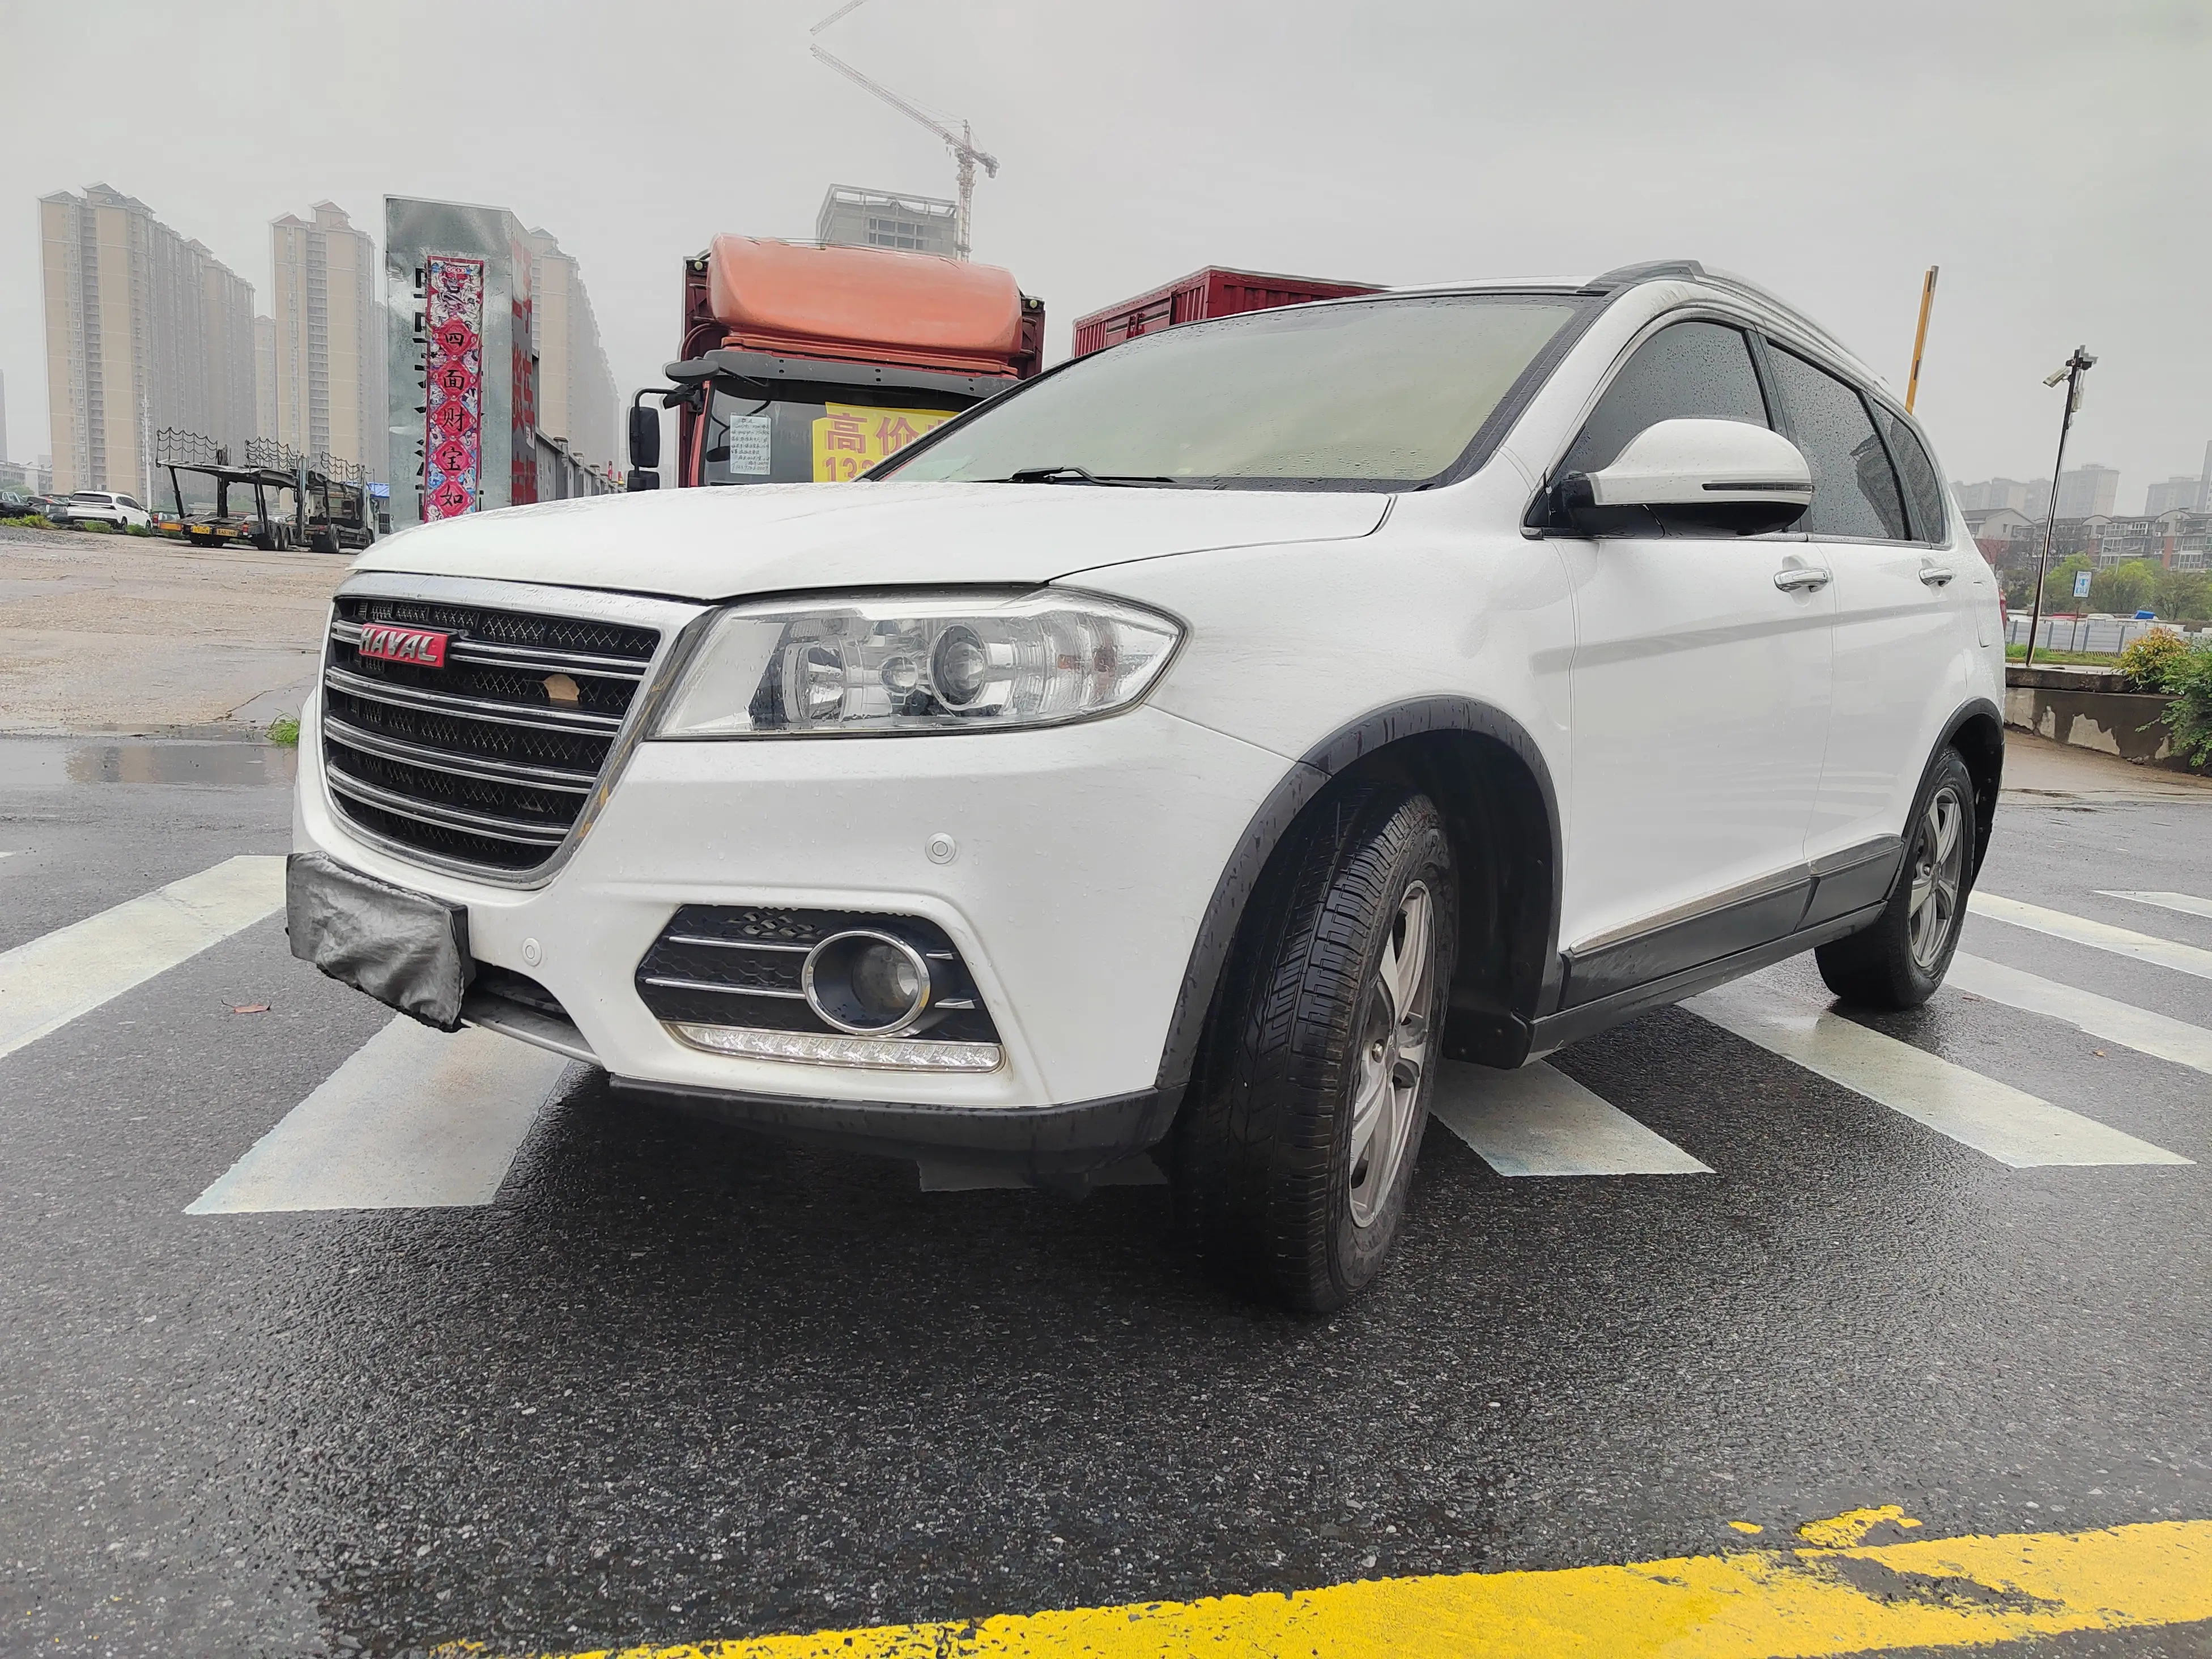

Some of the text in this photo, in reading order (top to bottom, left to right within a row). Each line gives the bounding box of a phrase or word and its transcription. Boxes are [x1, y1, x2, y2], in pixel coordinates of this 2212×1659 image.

[440, 331, 465, 507] 四面财宝如
[826, 412, 945, 456] 高价
[360, 627, 437, 662] HAVAL
